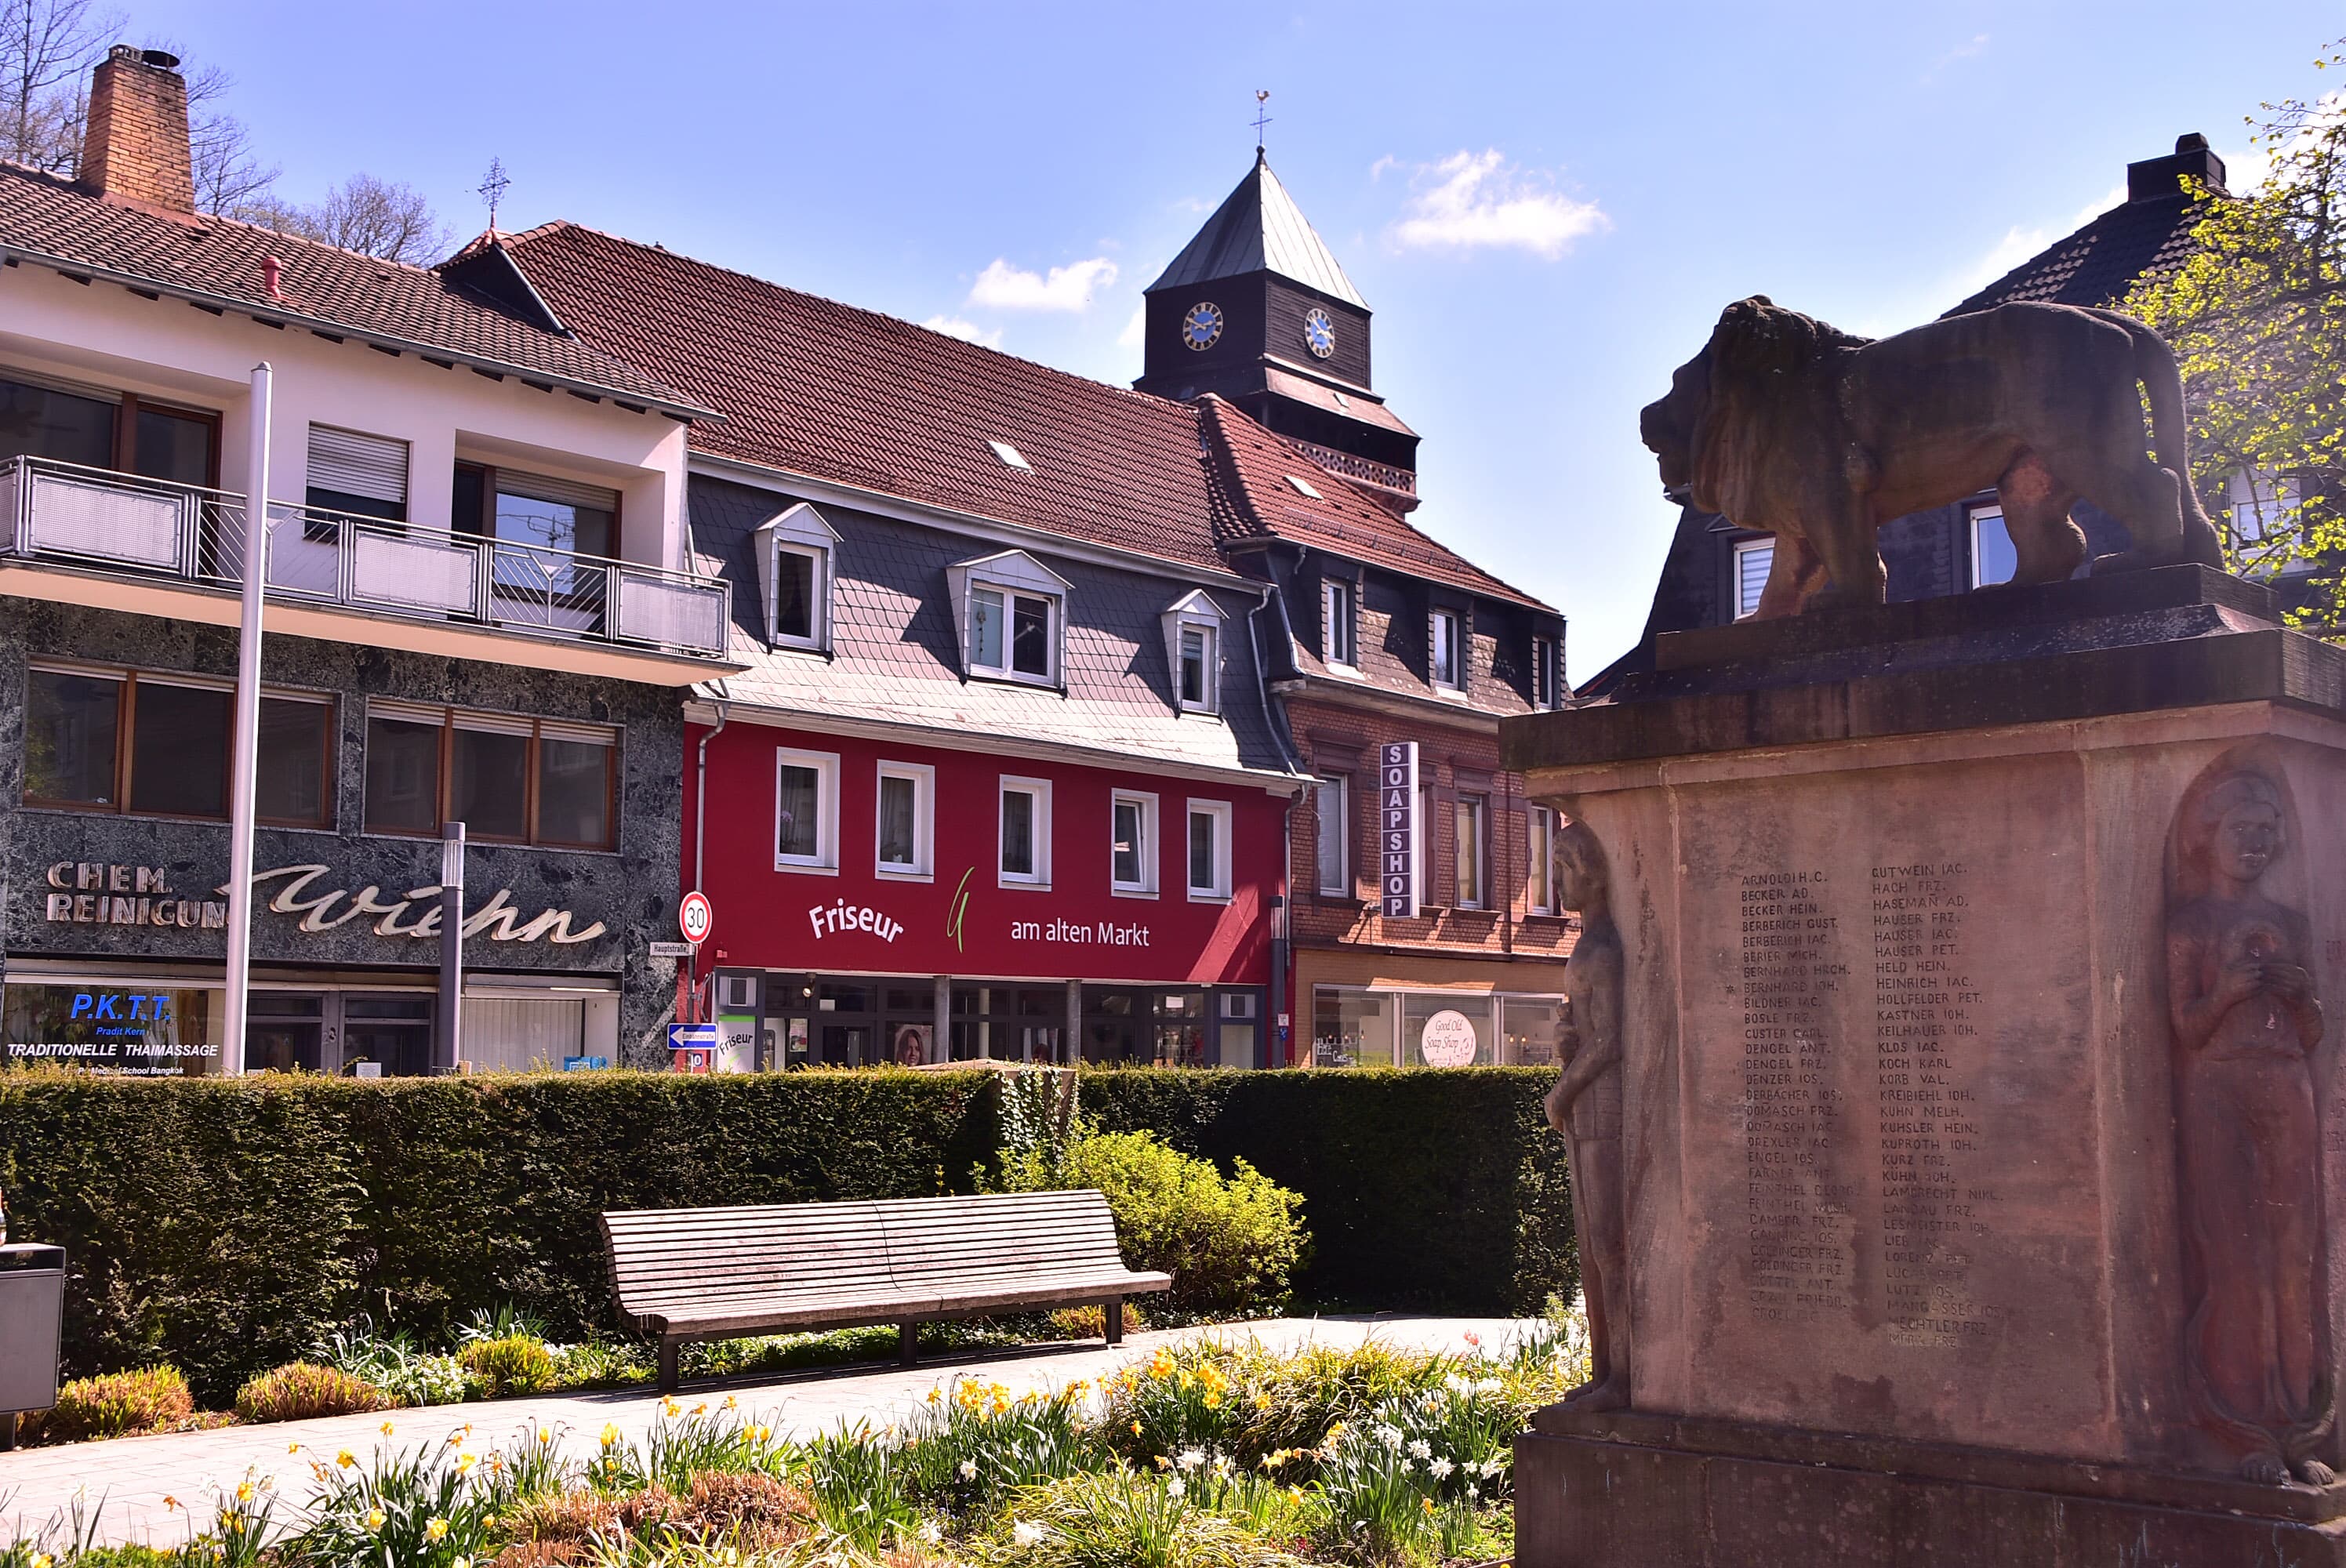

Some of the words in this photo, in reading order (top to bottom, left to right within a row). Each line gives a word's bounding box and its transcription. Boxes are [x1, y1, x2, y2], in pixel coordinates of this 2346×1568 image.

[46, 861, 174, 895] CHEM.
[1872, 865, 1934, 879] GUTWEIN
[1741, 889, 1785, 902] BECKER
[1792, 887, 1814, 898] AD.
[1872, 881, 1908, 895] HACH
[1946, 895, 1969, 907] AD.
[45, 892, 230, 928] REINIGUN
[1741, 905, 1783, 916] BECKER
[1790, 903, 1822, 914] HEIN.
[687, 907, 705, 929] 30
[808, 898, 903, 943] Friseur
[1742, 920, 1800, 932] BERBERICH
[1807, 917, 1839, 928] GUST.
[1873, 913, 1923, 926] HAUSER
[1011, 920, 1040, 941] am
[1045, 916, 1091, 943] alten
[1098, 922, 1150, 946] Markt
[1875, 929, 1923, 942] HAUSER
[1743, 935, 1802, 948] BERBERICH
[655, 944, 687, 954] Hauptstraße
[1875, 945, 1923, 957] HAUSER
[1932, 944, 1959, 955] PET.
[1744, 965, 1807, 978] BERNHARD
[1876, 962, 1907, 973] HELD
[1916, 960, 1951, 971] HEIN.
[1745, 982, 1807, 993] BERNHARD
[1876, 978, 1937, 989] HEINRICH
[1876, 993, 1949, 1005] HOLLFELDER
[71, 993, 171, 1021] P.K.T.T.
[1877, 1010, 1934, 1021] KASTNER
[96, 1027, 122, 1036] Pradit
[1877, 1025, 1946, 1036] KEILHAUER
[719, 1032, 754, 1055] Friseur
[1425, 1036, 1441, 1053] Soap
[1442, 1035, 1459, 1053] Shop
[1878, 1042, 1907, 1054] KLOS
[8, 1044, 118, 1056] TRADITIONELLE
[125, 1044, 219, 1057] THAIMASSAGE
[1879, 1058, 1910, 1069] KOCH
[1919, 1058, 1952, 1069] KARL
[151, 1067, 183, 1076] Bangkok
[1746, 1074, 1792, 1085] DENZER
[1879, 1073, 1908, 1085] KORB
[1920, 1073, 1949, 1085] VAL.
[1881, 1106, 1913, 1117] KUHN
[1945, 1123, 1978, 1134] HEIN.
[1882, 1153, 1914, 1165] KURZ
